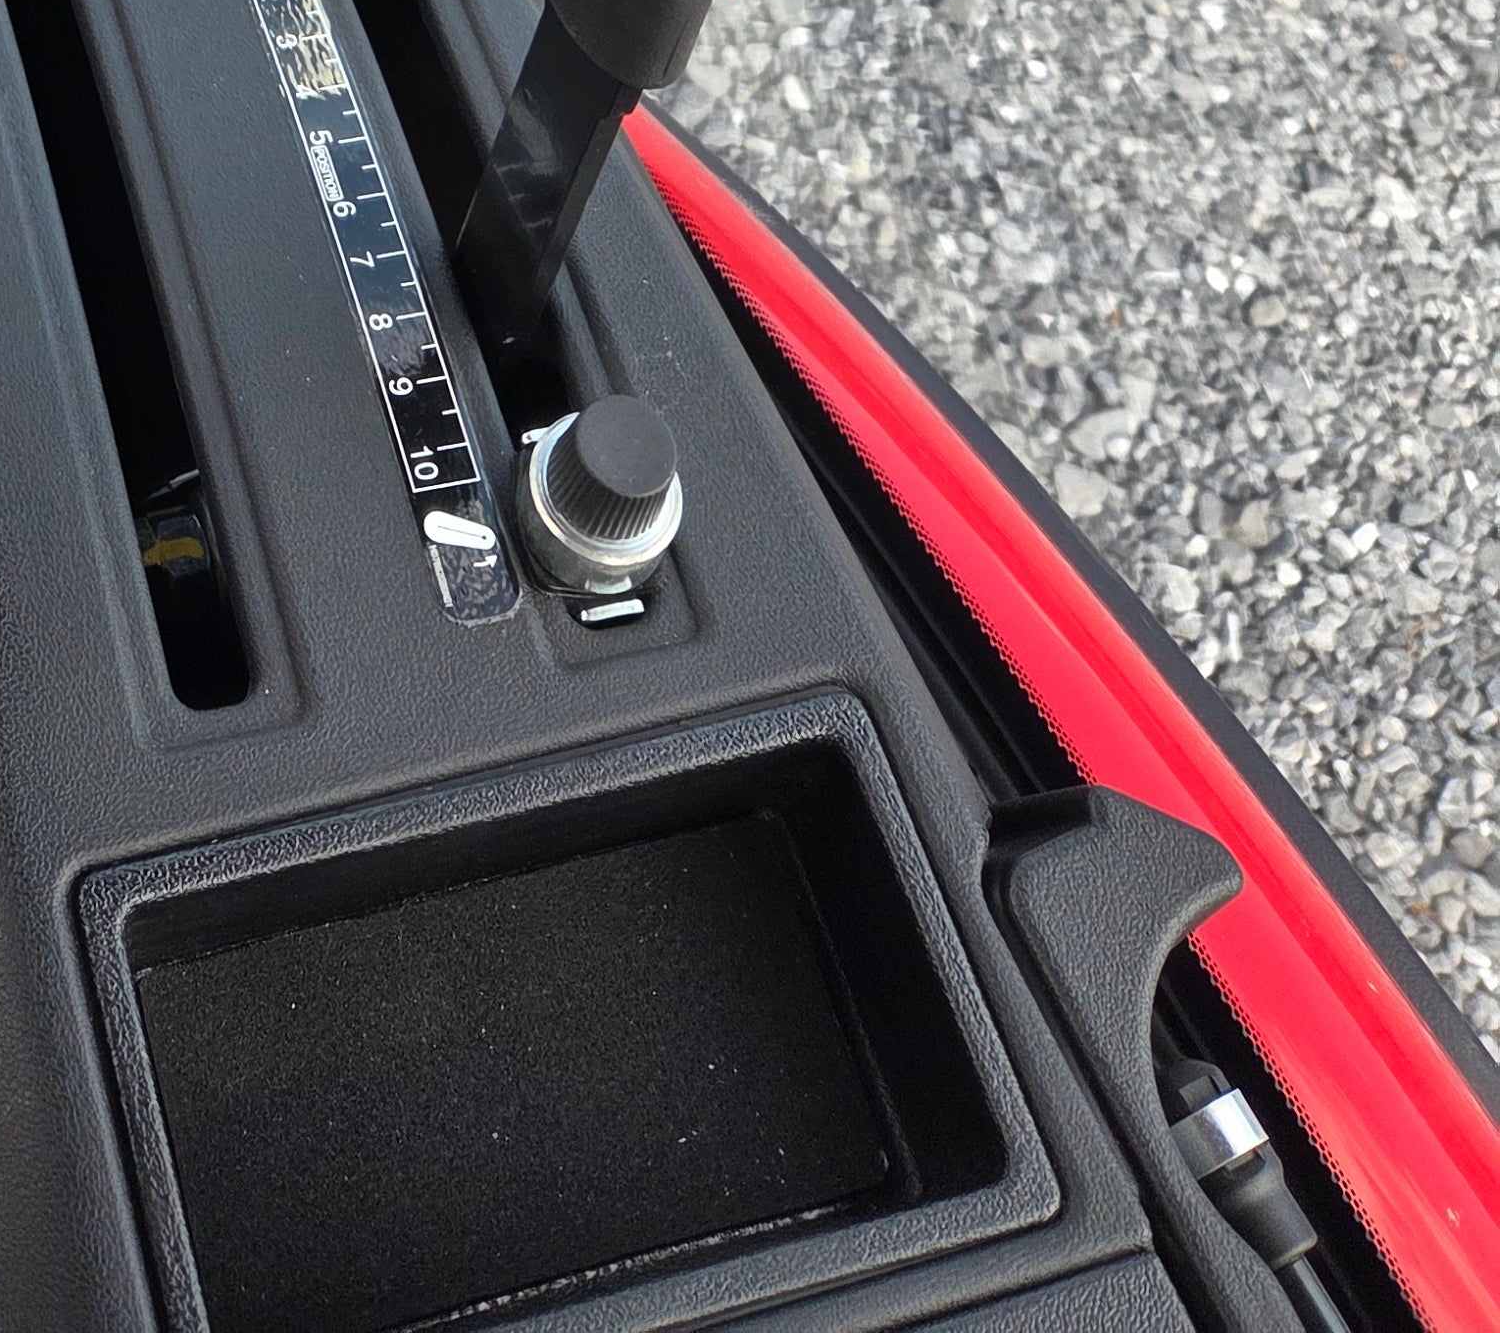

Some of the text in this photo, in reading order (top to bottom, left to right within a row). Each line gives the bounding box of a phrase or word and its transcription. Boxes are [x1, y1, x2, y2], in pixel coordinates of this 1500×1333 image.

[276, 34, 298, 50] 3
[309, 129, 334, 145] 5
[313, 147, 341, 200] POSITION
[332, 201, 357, 218] 6
[349, 250, 376, 269] 7
[368, 313, 394, 331] 8
[388, 376, 414, 396] 9
[409, 445, 439, 481] 10
